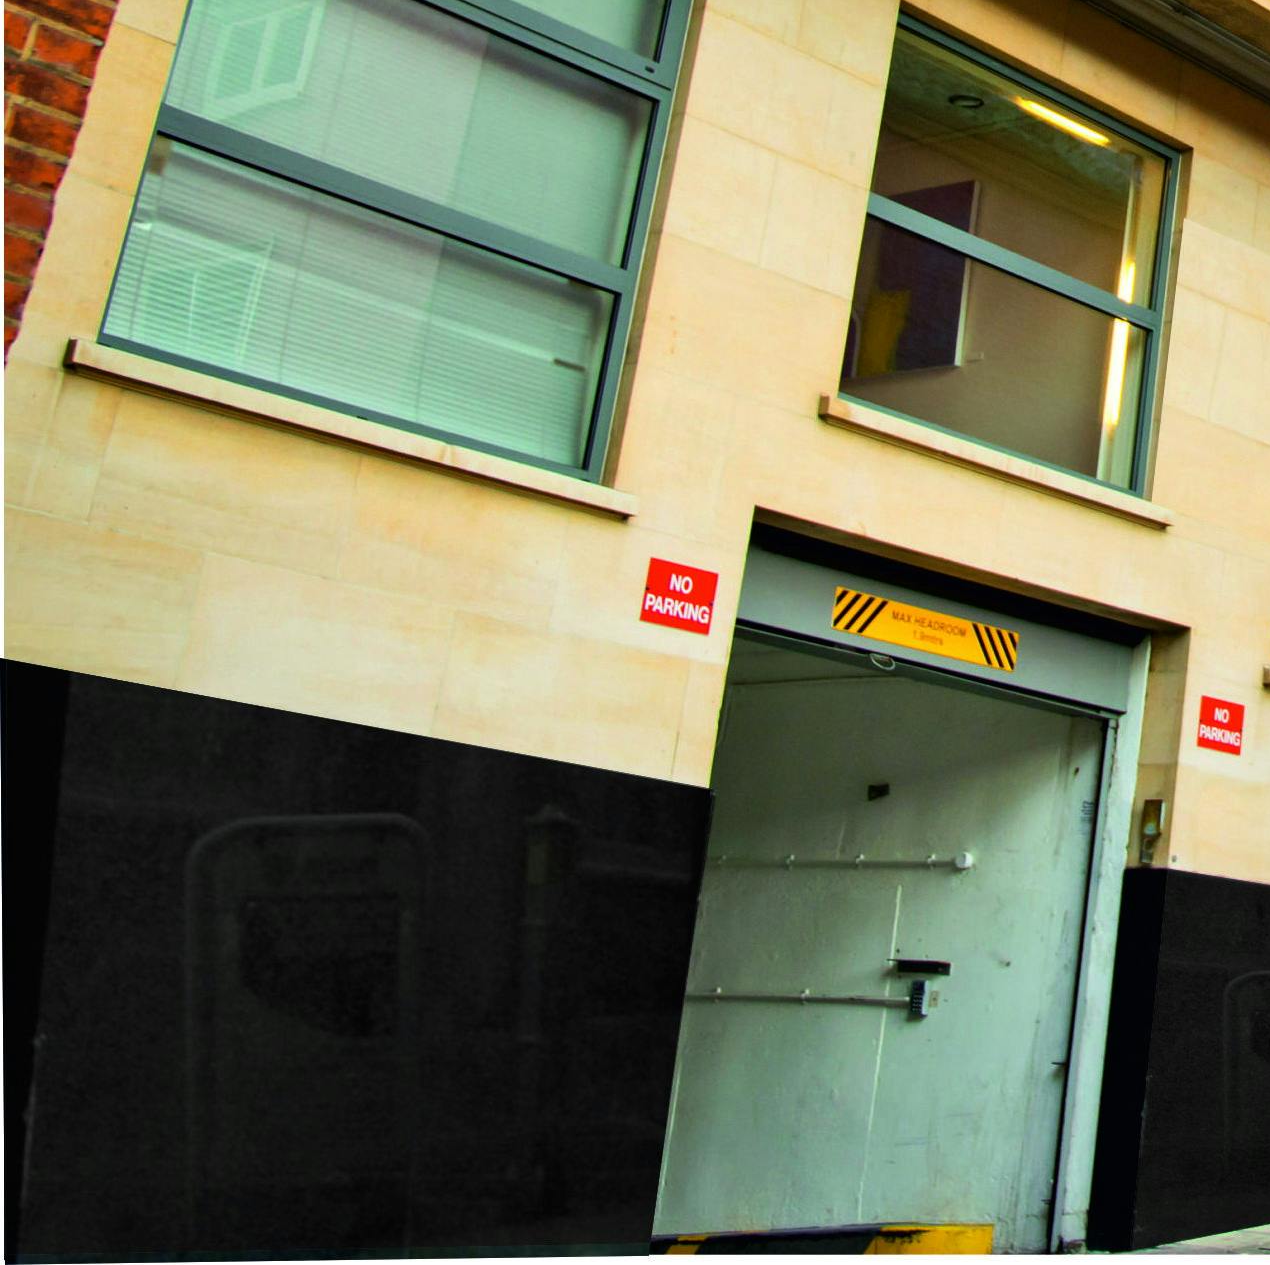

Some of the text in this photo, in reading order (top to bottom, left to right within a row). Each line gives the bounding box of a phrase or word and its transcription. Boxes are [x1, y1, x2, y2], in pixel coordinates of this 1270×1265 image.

[669, 573, 693, 594] NO
[643, 593, 710, 624] PARKING
[892, 610, 967, 638] MAX HEADROOM
[1214, 707, 1230, 723] NO
[1199, 724, 1240, 746] PARKING
